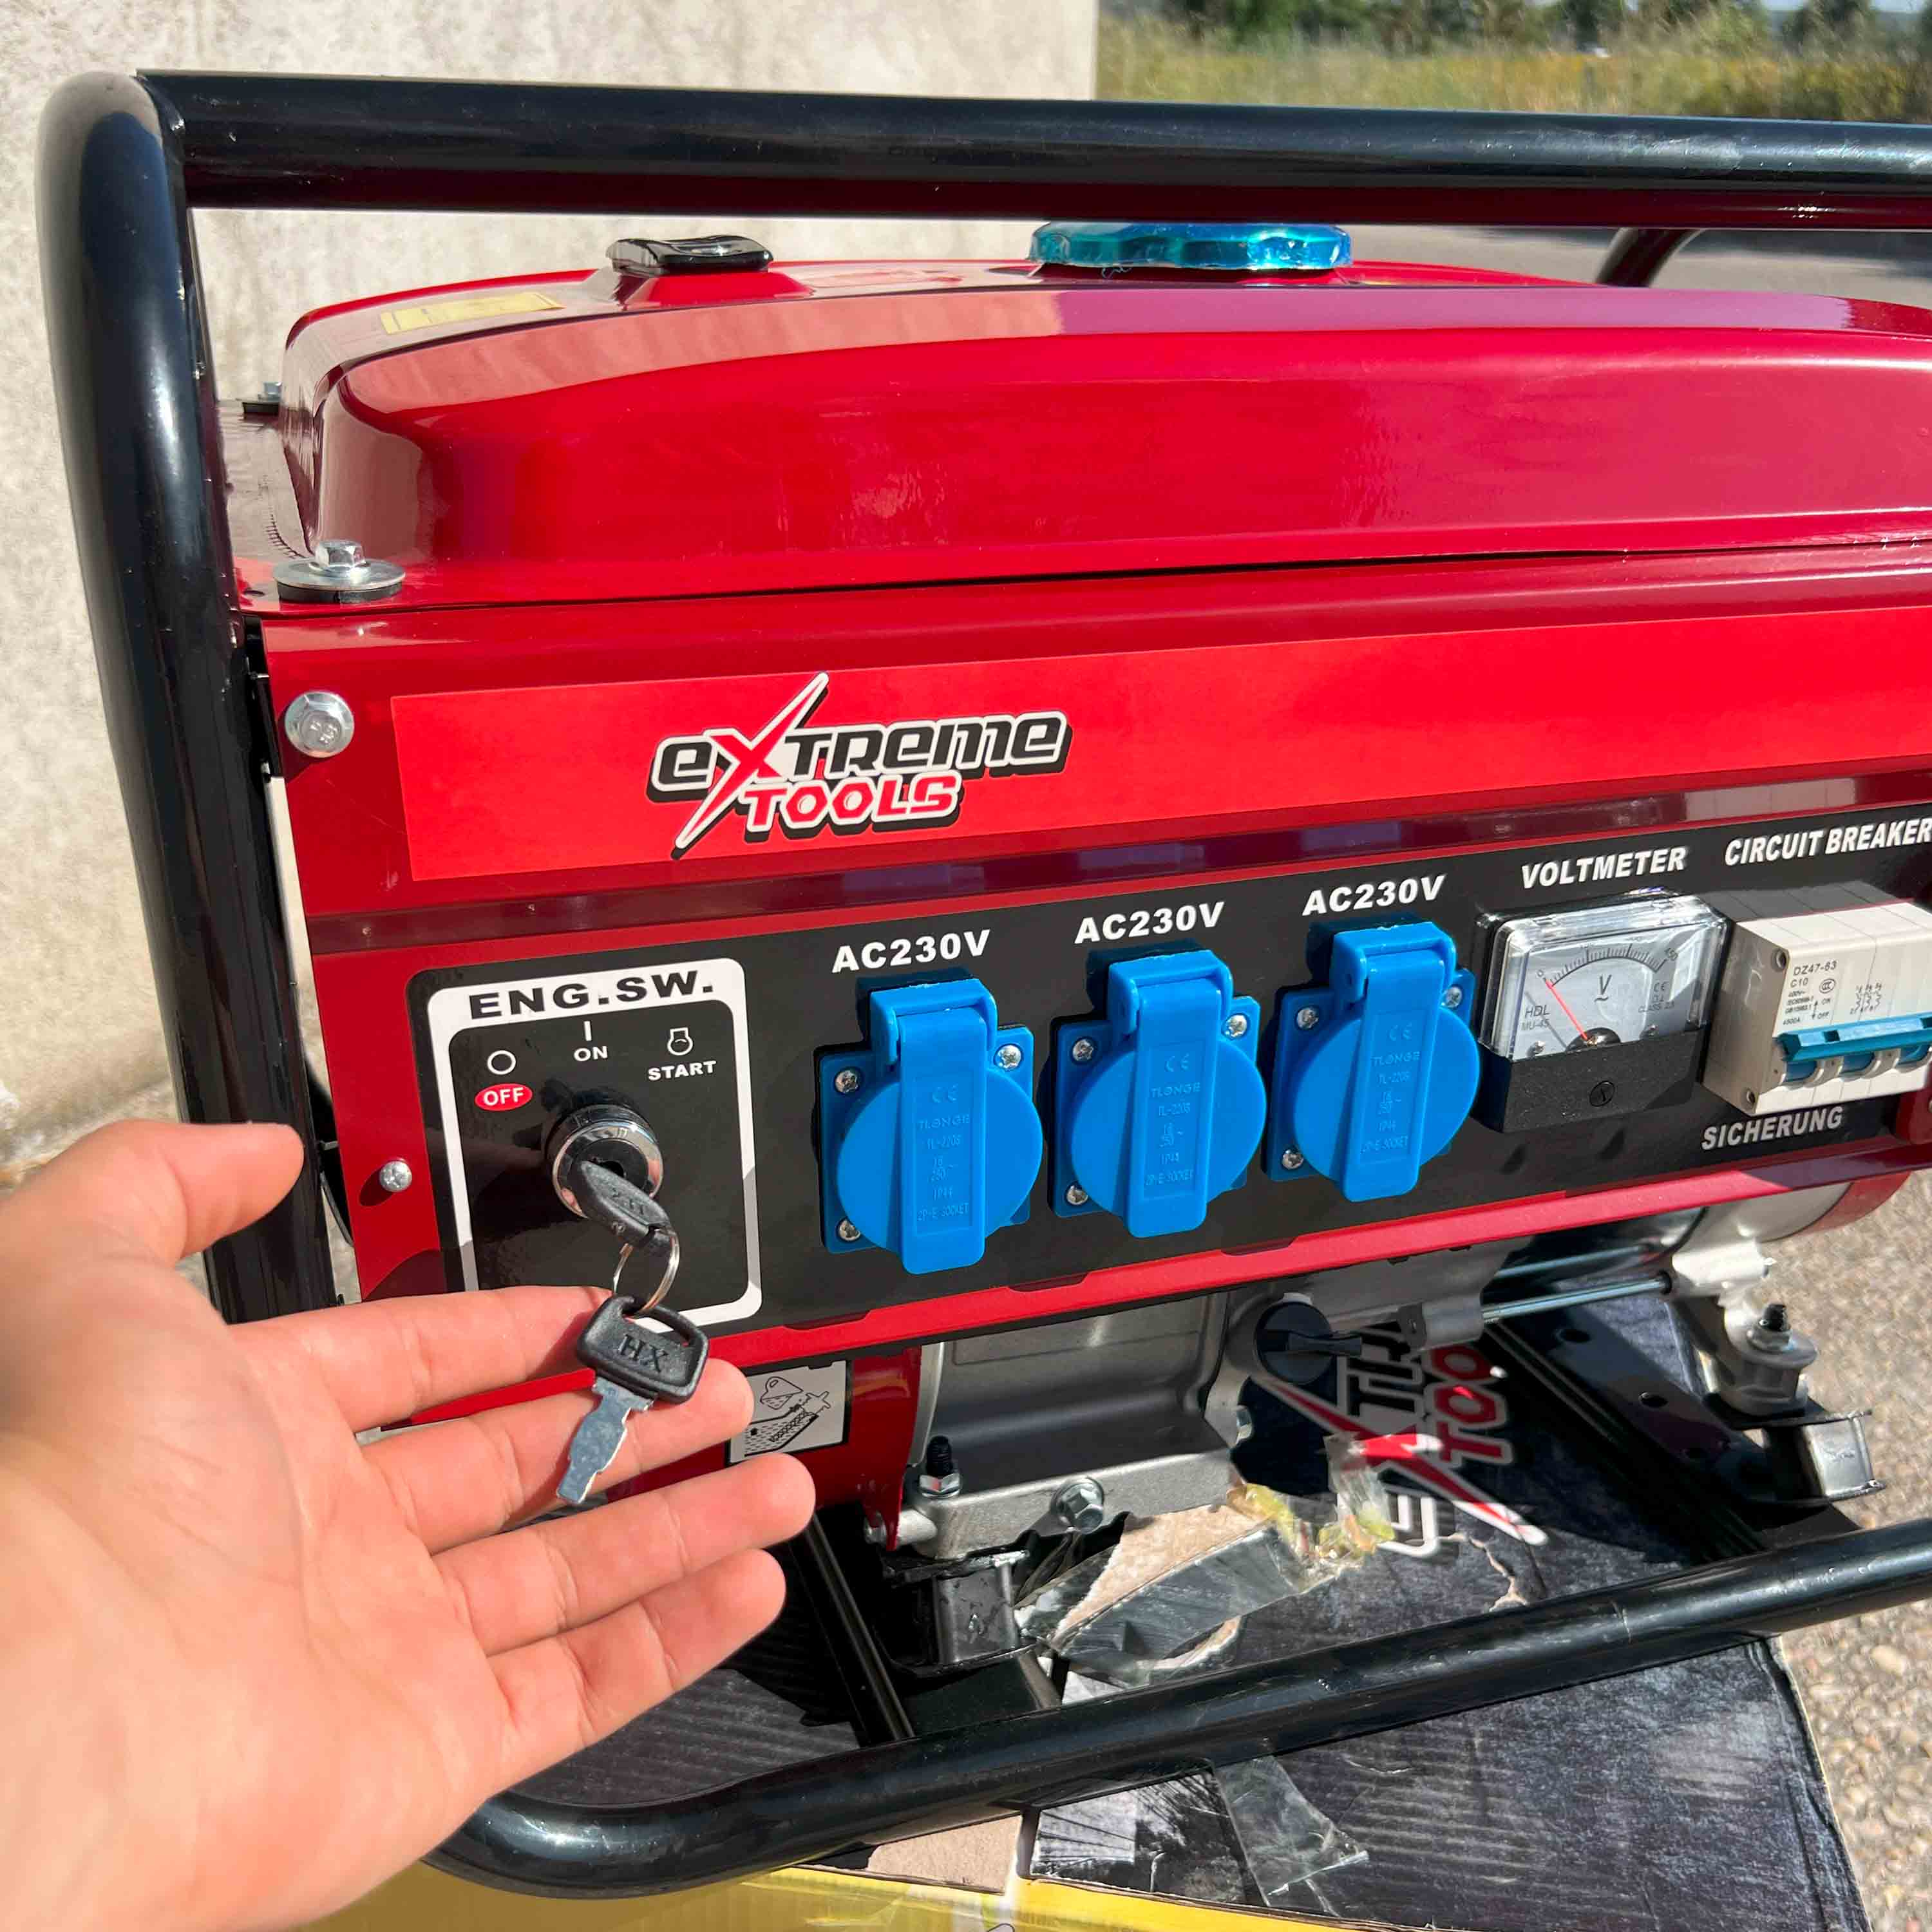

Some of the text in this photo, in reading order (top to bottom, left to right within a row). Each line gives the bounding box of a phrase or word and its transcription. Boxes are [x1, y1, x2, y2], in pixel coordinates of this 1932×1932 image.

[741, 772, 963, 842] TOOLS
[1725, 817, 1932, 866] CIRCUIT BREAKER
[1521, 846, 1687, 889] VOLTMETER
[1302, 875, 1446, 916] AC230V
[1074, 902, 1225, 944] AC230V
[831, 929, 990, 973] AC230V
[469, 969, 713, 1019] ENG.SW.
[1598, 974, 1612, 996] V
[1524, 1004, 1551, 1018] HDL
[574, 1045, 608, 1062] ON
[648, 1060, 717, 1081] START
[483, 1087, 524, 1106] OFF
[1701, 1106, 1842, 1151] SICHERUNG
[618, 1334, 669, 1373] HX
[1423, 1345, 1513, 1469] TOO
